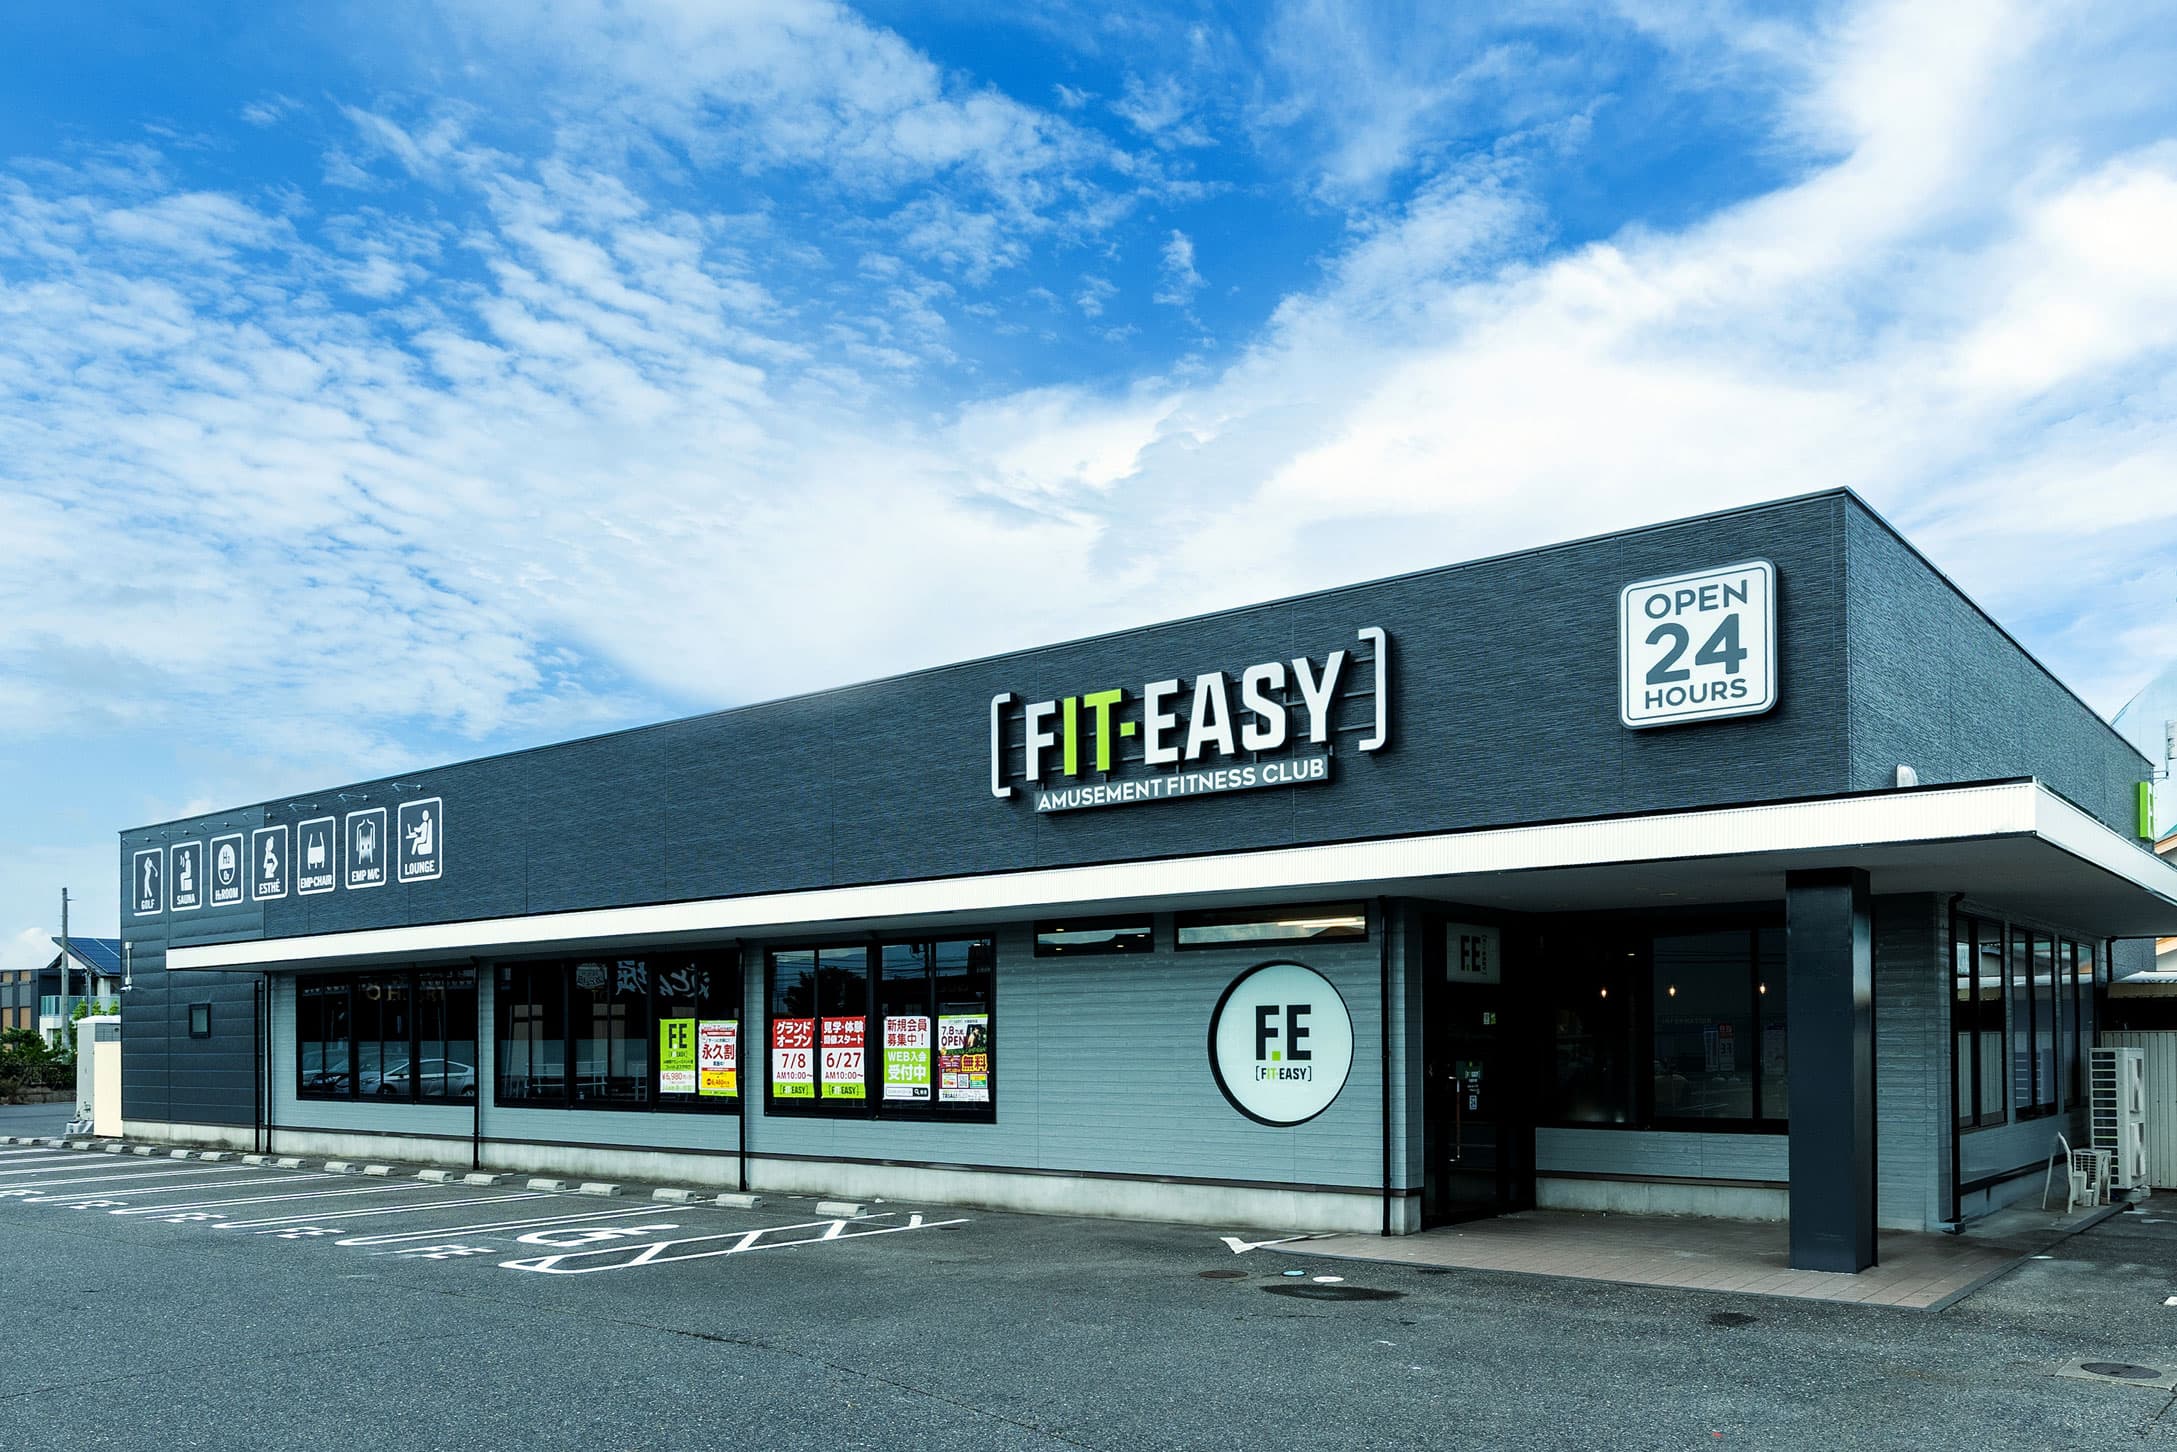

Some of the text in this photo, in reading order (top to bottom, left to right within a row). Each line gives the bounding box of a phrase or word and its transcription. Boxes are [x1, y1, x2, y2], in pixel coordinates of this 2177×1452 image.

[1644, 579, 1748, 619] OPEN
[1645, 613, 1747, 686] 24
[1645, 678, 1748, 709] HOURS
[1037, 757, 1324, 811] AMUSEMENT FITNESS CLUB
[404, 860, 435, 876] LOUNGE
[141, 899, 155, 910] GOLF
[177, 894, 196, 905] SAUNA
[776, 1021, 811, 1034] グランド
[887, 1019, 927, 1032] 新規会員
[777, 1034, 812, 1047] オープン
[941, 1036, 965, 1047] OPEN
[702, 1044, 735, 1060] 永久割
[826, 1052, 861, 1068] 6/27
[887, 1051, 927, 1062] WEB入会
[781, 1053, 806, 1069] 7/8
[963, 1054, 986, 1071] 無料
[888, 1064, 926, 1081] 受付中
